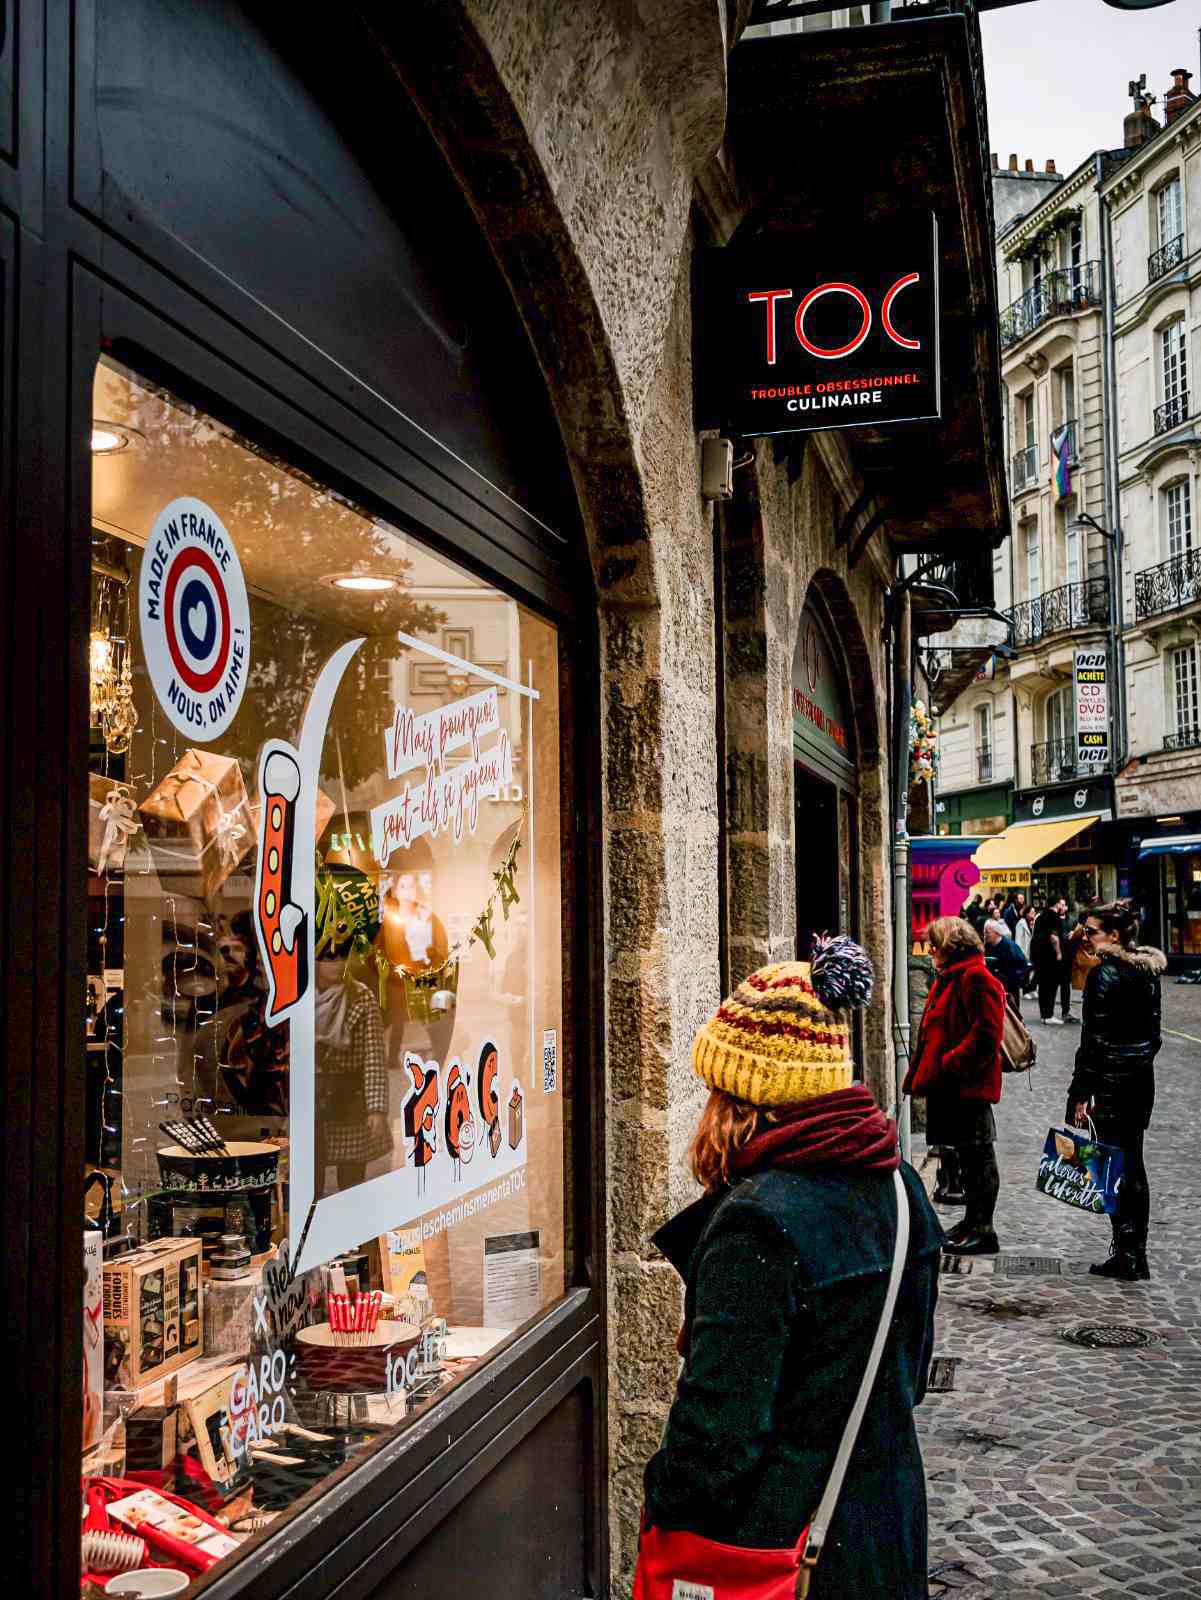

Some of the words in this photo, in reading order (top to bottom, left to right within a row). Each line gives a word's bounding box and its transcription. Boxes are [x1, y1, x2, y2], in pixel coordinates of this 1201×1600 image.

[748, 271, 921, 365] TOC
[751, 384, 812, 400] TROUBLE
[816, 373, 921, 394] OBSESSIONNEL
[786, 390, 883, 412] CULINAIRE
[147, 540, 169, 621] MADE
[164, 519, 180, 550] IN
[180, 513, 231, 573] FRANCE
[1076, 654, 1106, 667] OCD
[208, 693, 226, 723] ON
[222, 641, 245, 702] AIME
[1080, 685, 1101, 696] CD
[1079, 704, 1105, 714] DVD
[1083, 734, 1104, 745] CASH
[1078, 748, 1108, 761] OCD
[113, 1272, 122, 1320] FONDUES
